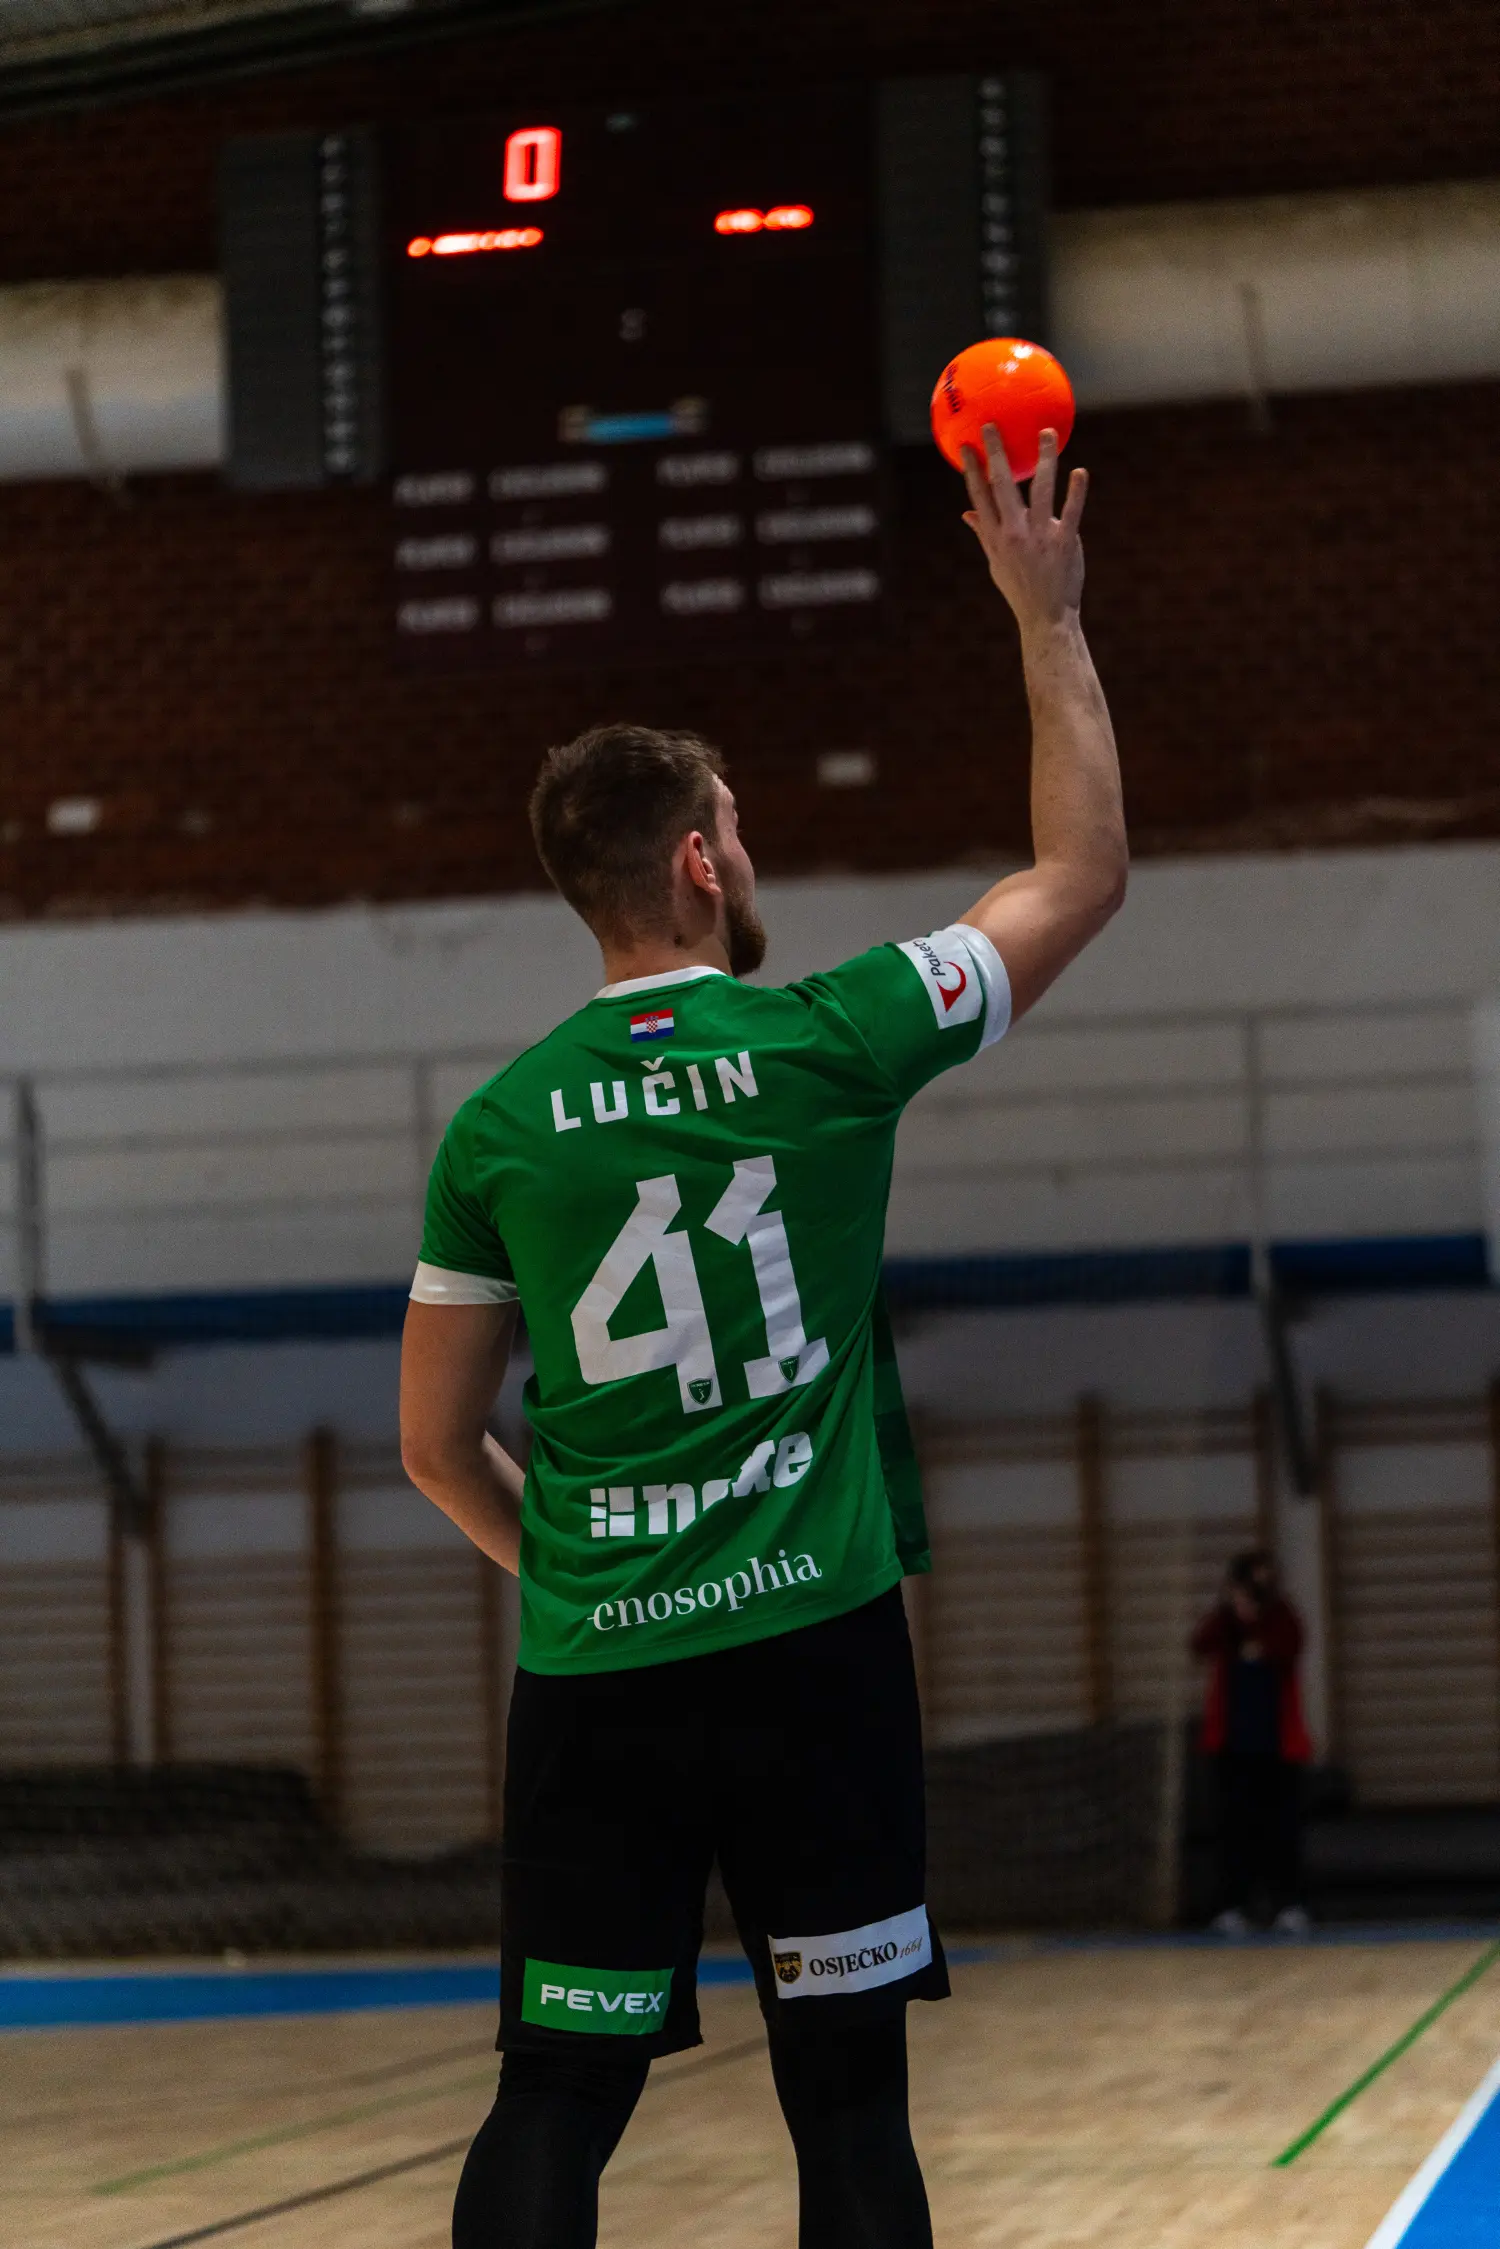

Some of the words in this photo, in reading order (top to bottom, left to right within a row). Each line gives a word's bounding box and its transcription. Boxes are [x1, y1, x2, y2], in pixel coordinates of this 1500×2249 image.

[550, 1050, 759, 1133] LUČIN
[570, 1155, 831, 1414] 41
[809, 1941, 898, 1978] OSJEČKO
[540, 1983, 665, 2014] PEVEX
